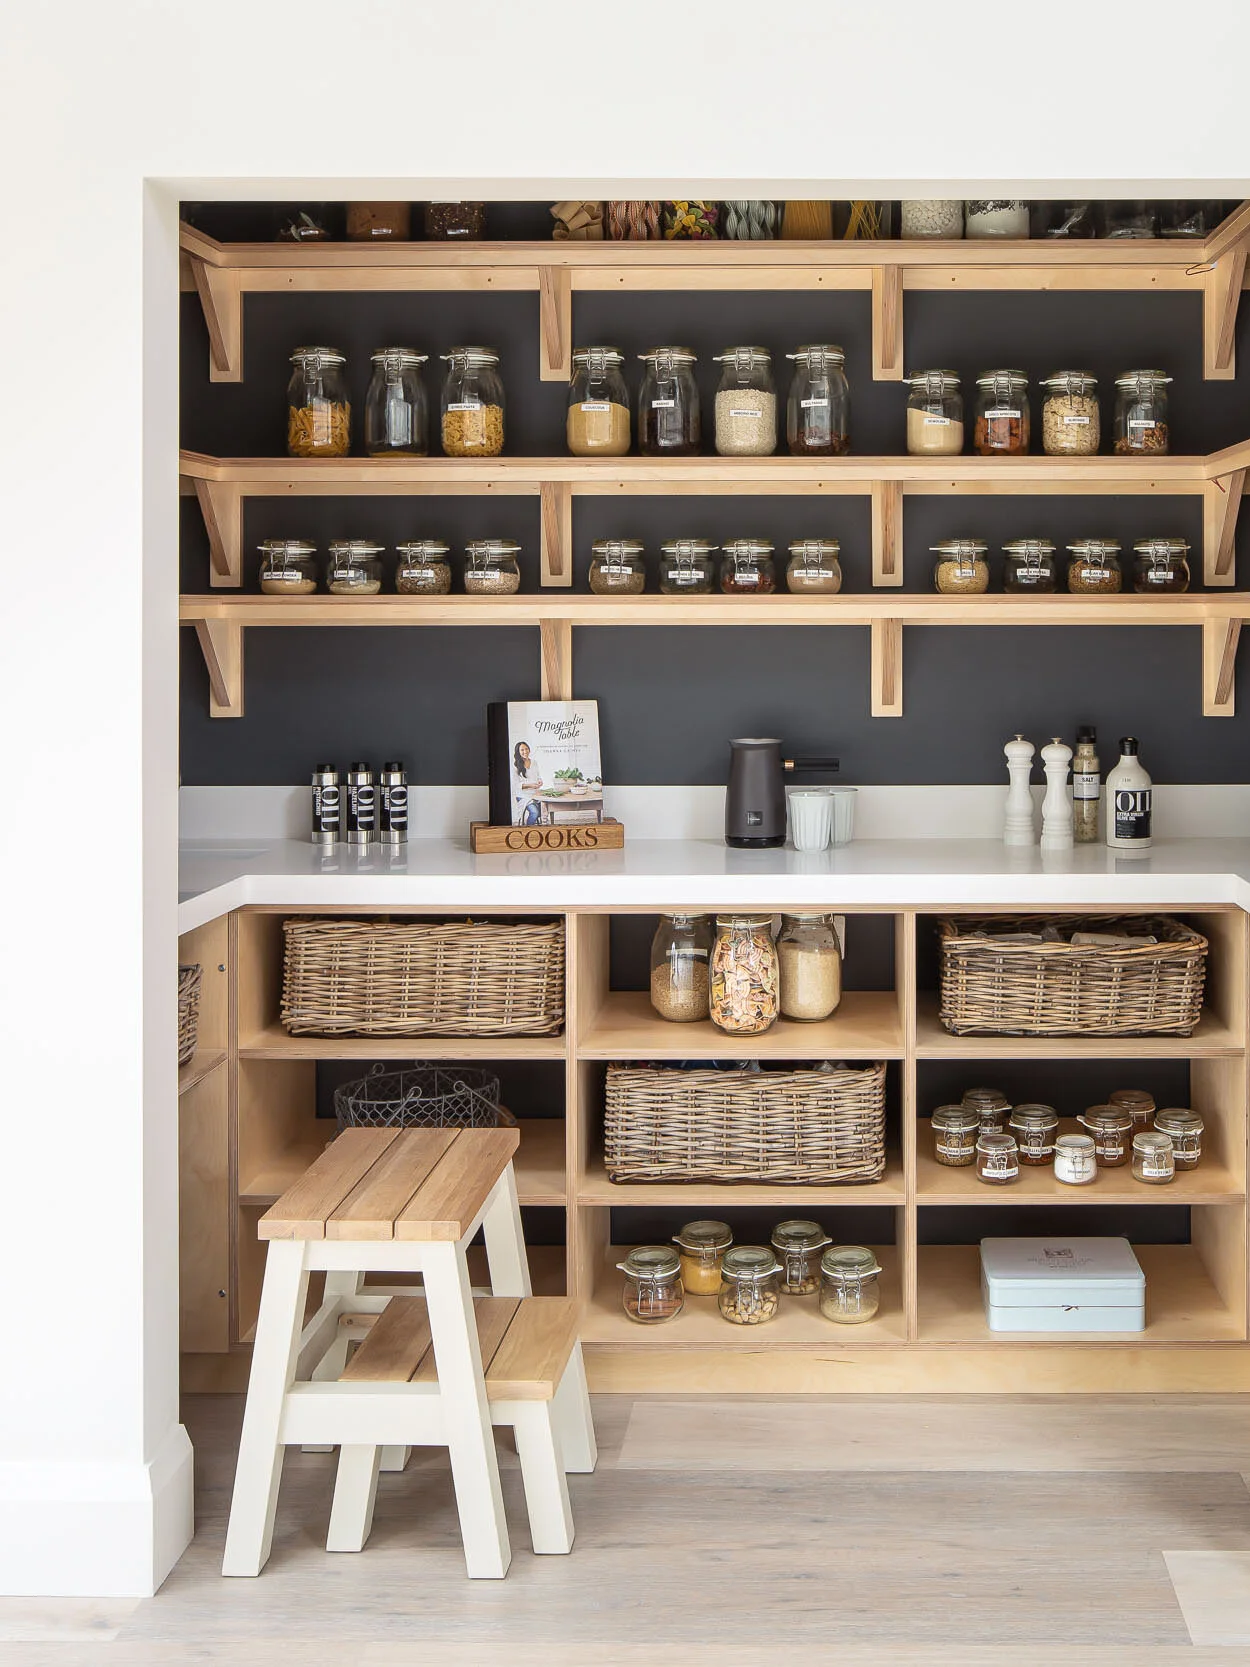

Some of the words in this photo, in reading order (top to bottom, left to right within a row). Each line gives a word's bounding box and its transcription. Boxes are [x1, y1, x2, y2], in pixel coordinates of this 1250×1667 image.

[534, 713, 584, 735] Magnolia
[558, 725, 580, 741] Table
[505, 827, 598, 850] COOKS
